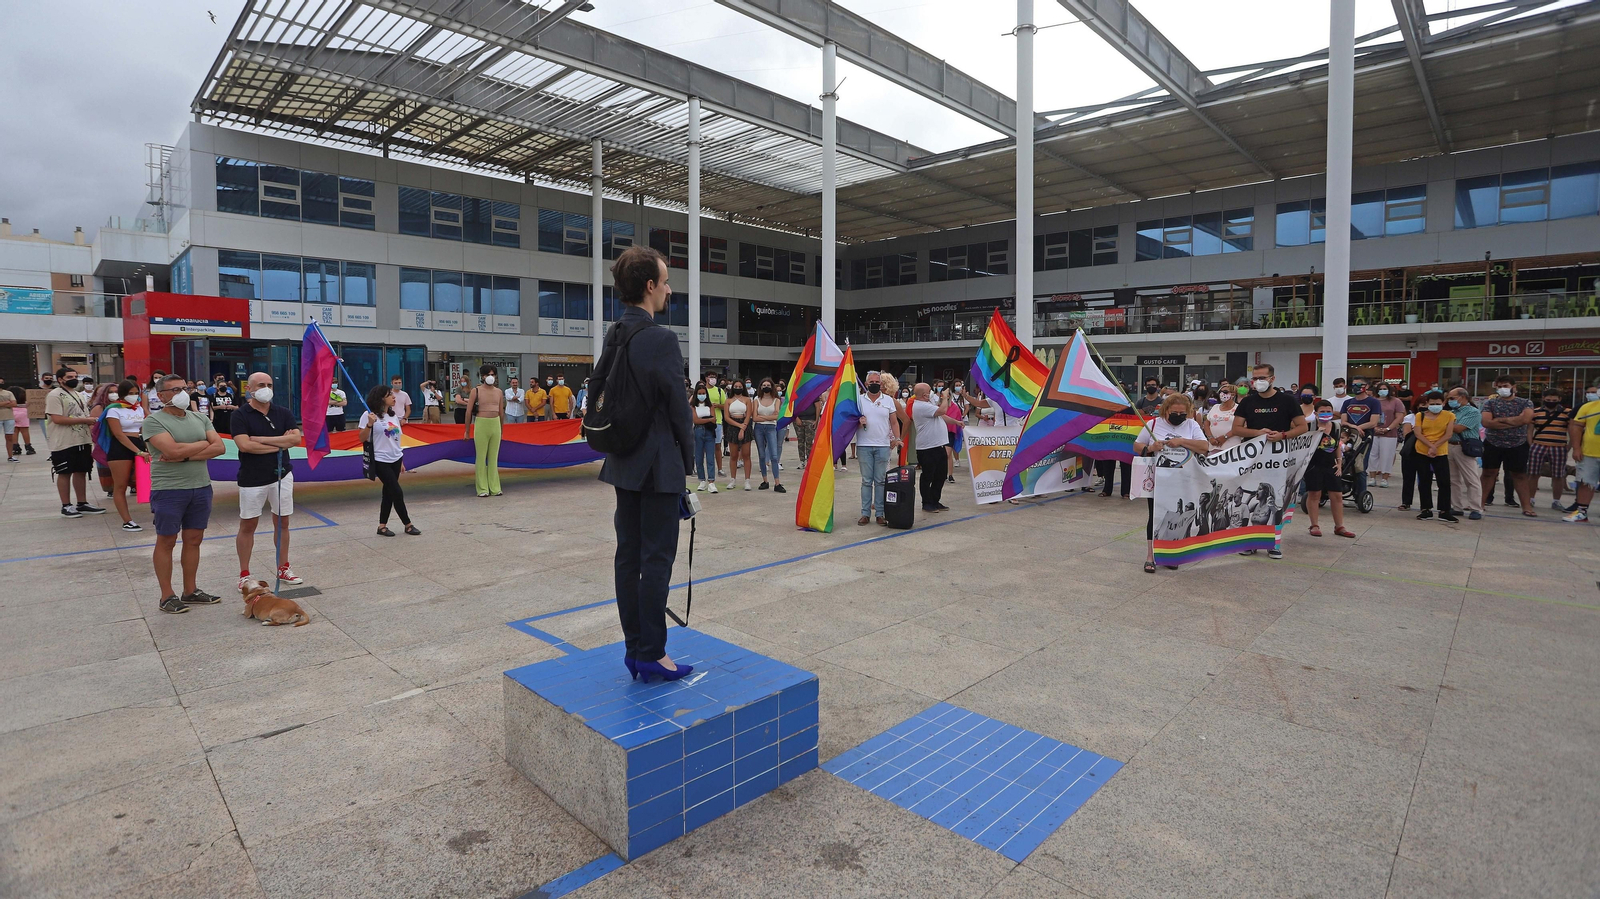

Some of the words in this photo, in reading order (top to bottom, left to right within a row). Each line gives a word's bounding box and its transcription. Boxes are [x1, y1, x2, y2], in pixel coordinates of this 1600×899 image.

[1488, 343, 1520, 355] Dia
[968, 436, 996, 446] TRANS
[1238, 461, 1263, 476] Campo
[1265, 459, 1280, 469] de
